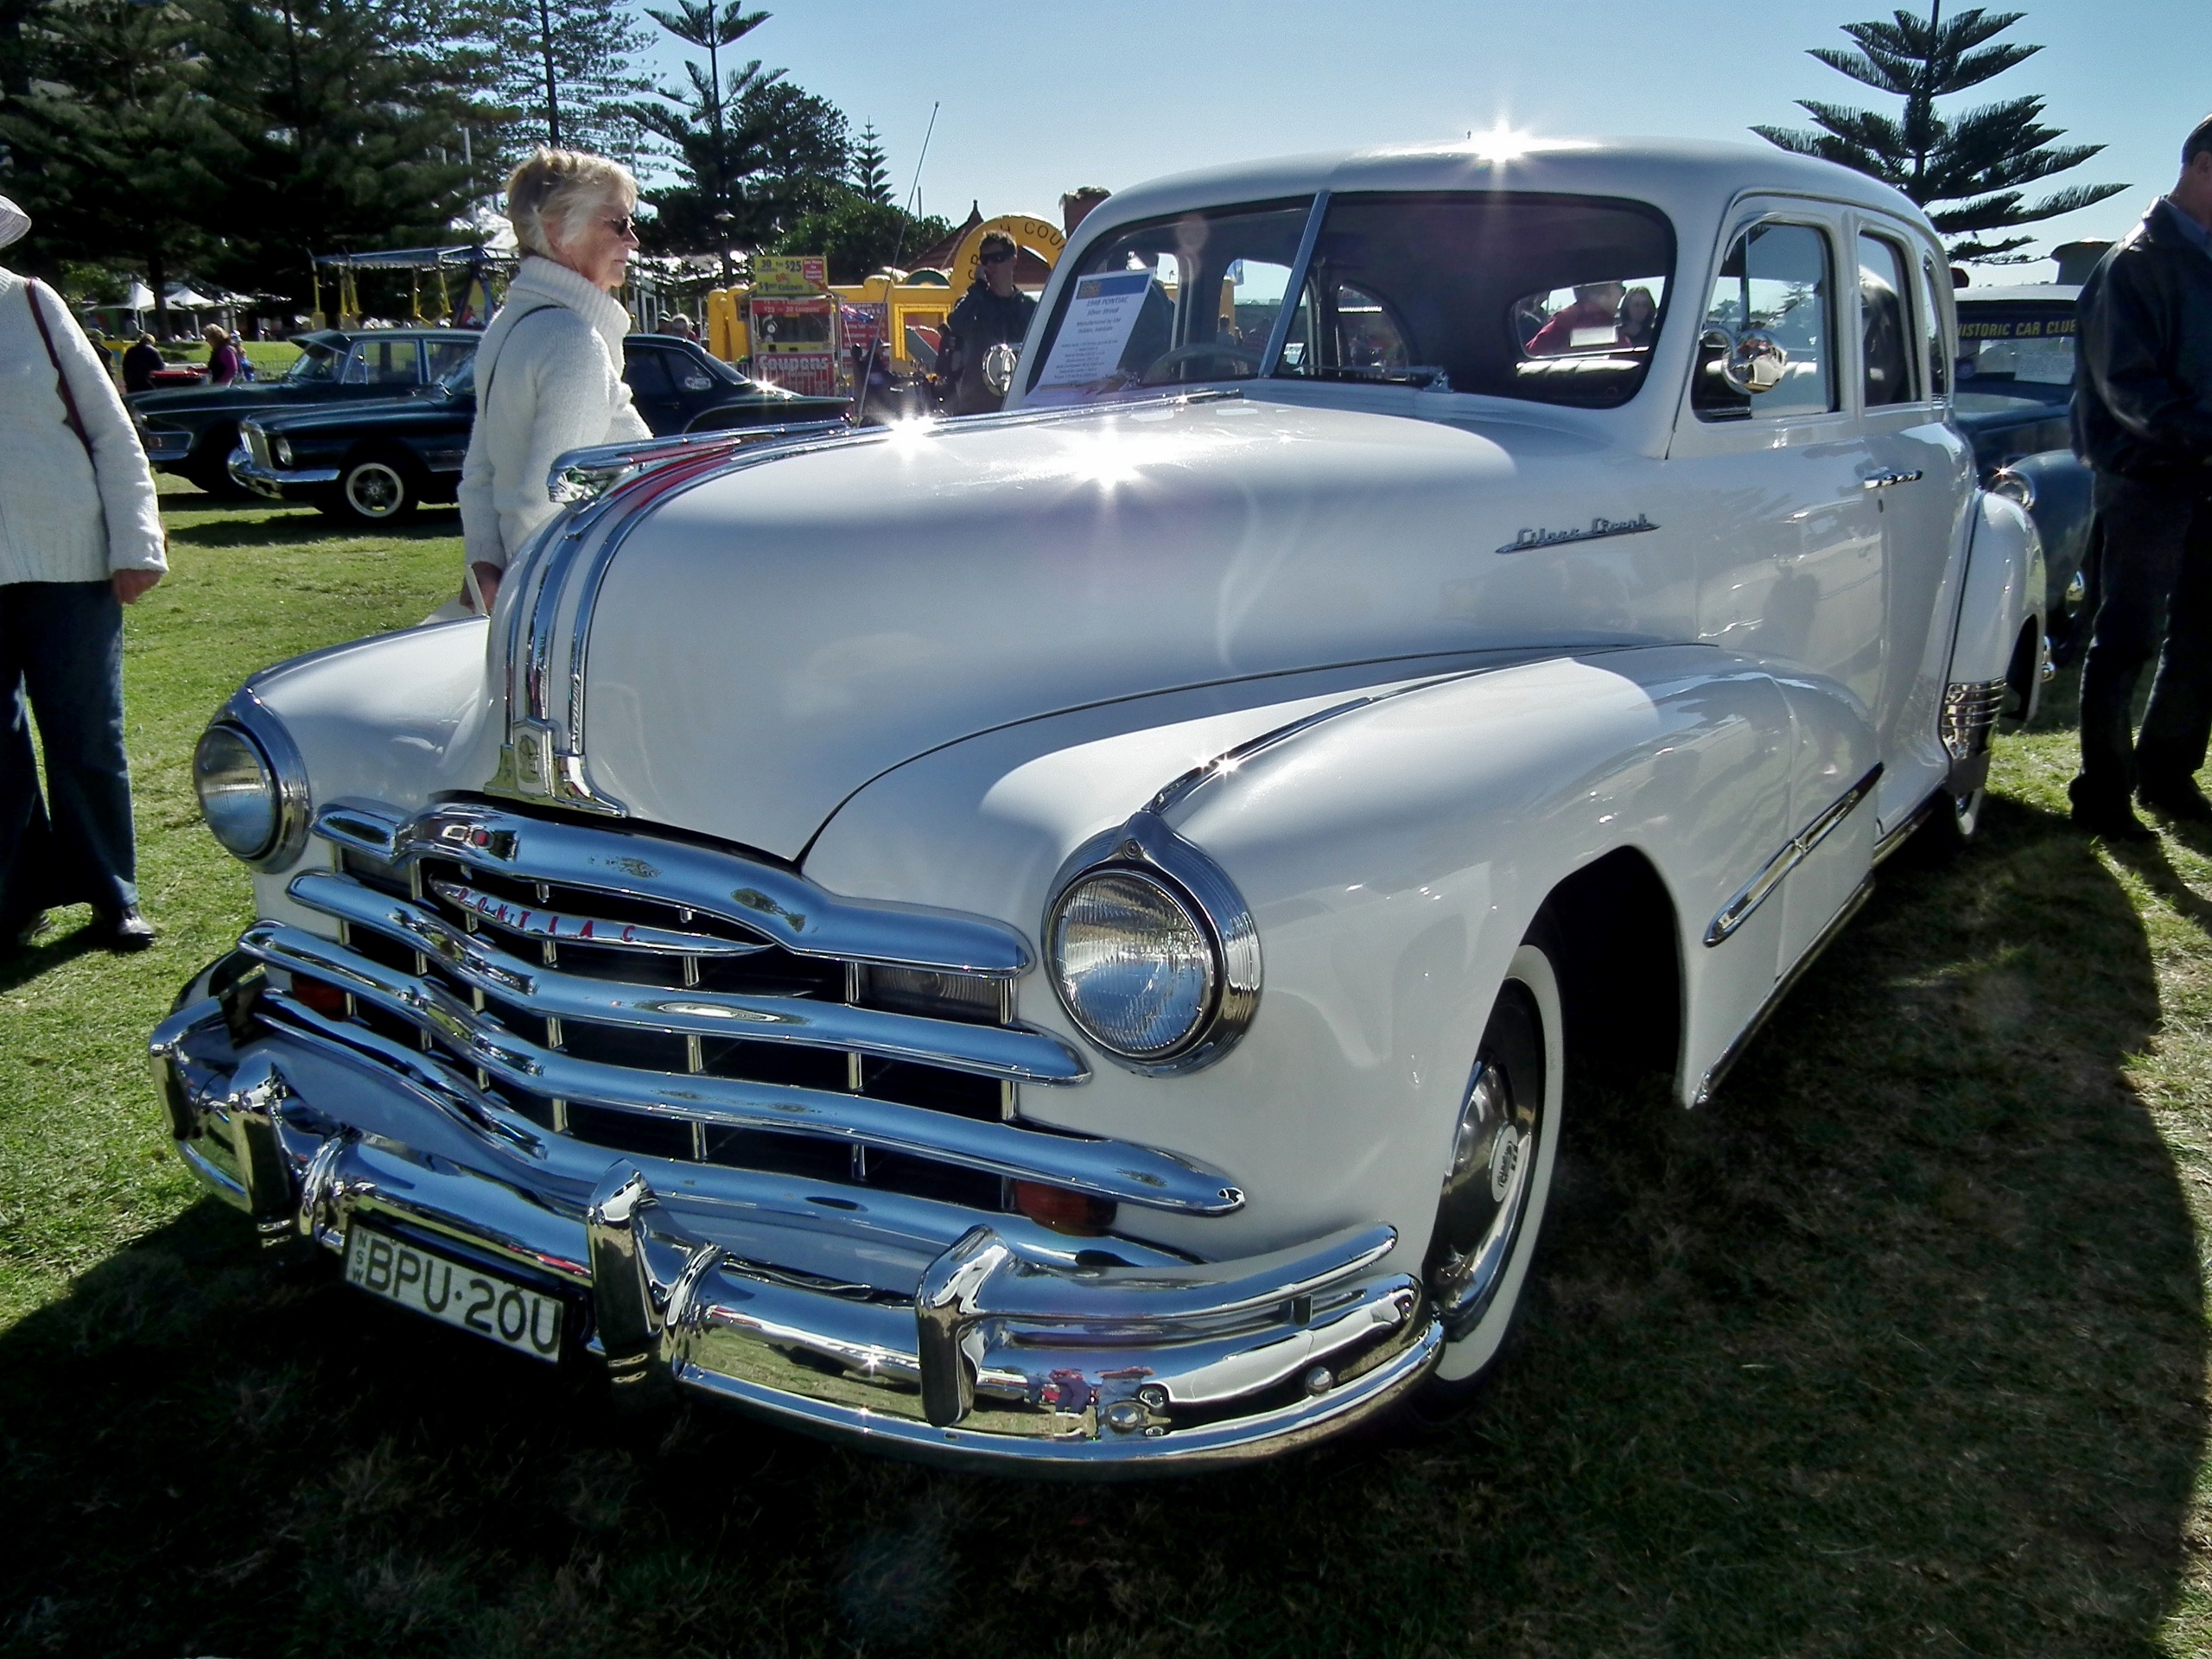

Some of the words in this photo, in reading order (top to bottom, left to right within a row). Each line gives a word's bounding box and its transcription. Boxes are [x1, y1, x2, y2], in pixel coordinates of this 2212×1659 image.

[785, 260, 801, 272] $25
[2015, 321, 2041, 336] CAR
[759, 355, 829, 372] Coupons
[456, 887, 636, 943] PONTIAC
